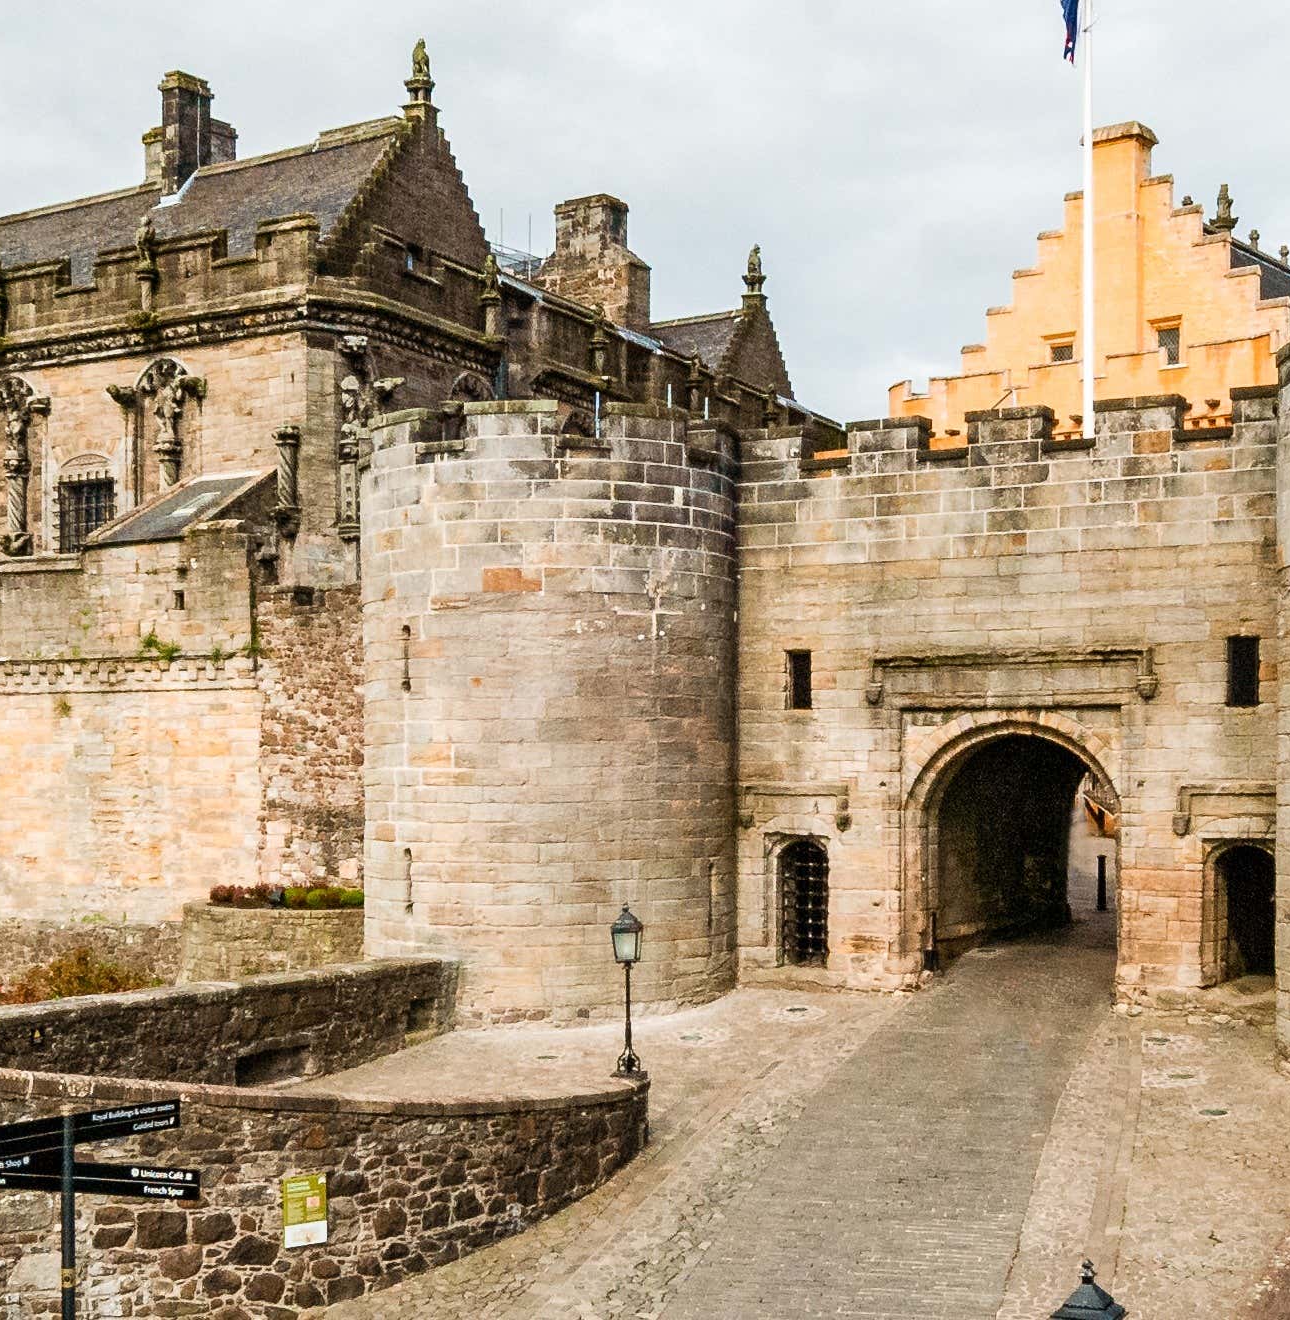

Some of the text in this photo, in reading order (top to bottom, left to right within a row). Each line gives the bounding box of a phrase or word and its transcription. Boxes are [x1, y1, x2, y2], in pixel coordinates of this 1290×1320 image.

[133, 1119, 169, 1131] Guided tours
[5, 1159, 22, 1169] Shop
[141, 1169, 184, 1180] Unicorn Café
[143, 1185, 184, 1197] French Spur
